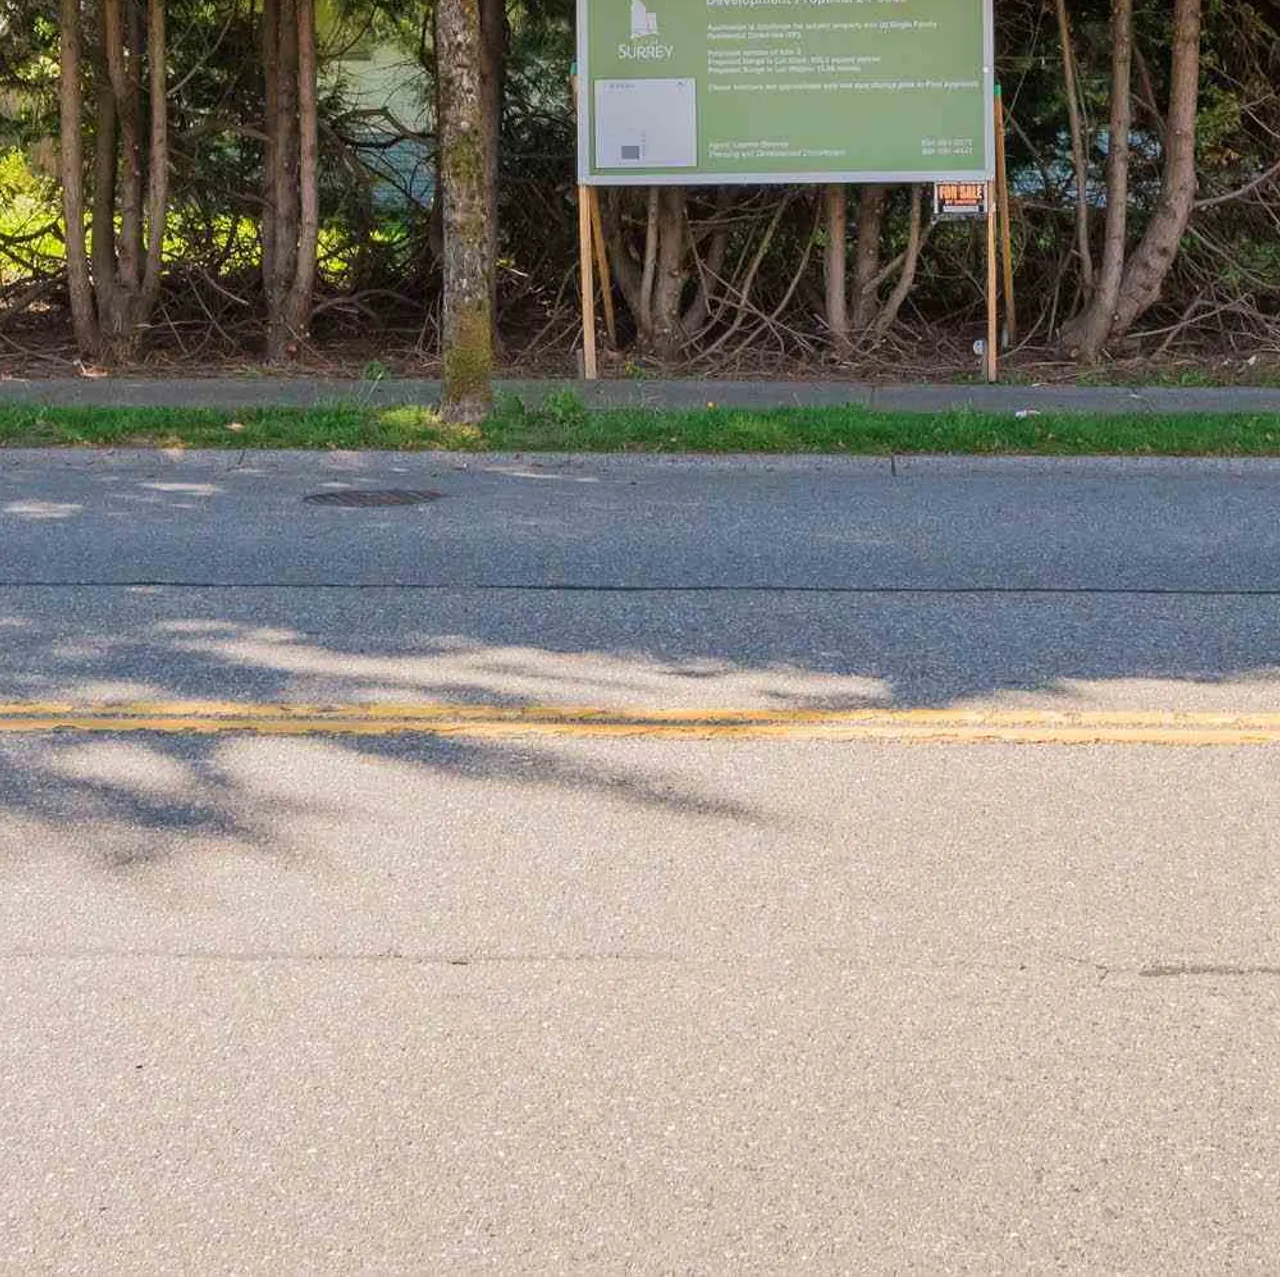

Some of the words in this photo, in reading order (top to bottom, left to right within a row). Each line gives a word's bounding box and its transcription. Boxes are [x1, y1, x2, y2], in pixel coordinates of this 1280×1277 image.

[618, 43, 674, 59] SURREY
[939, 184, 957, 199] FOR
[960, 184, 983, 199] SALE
